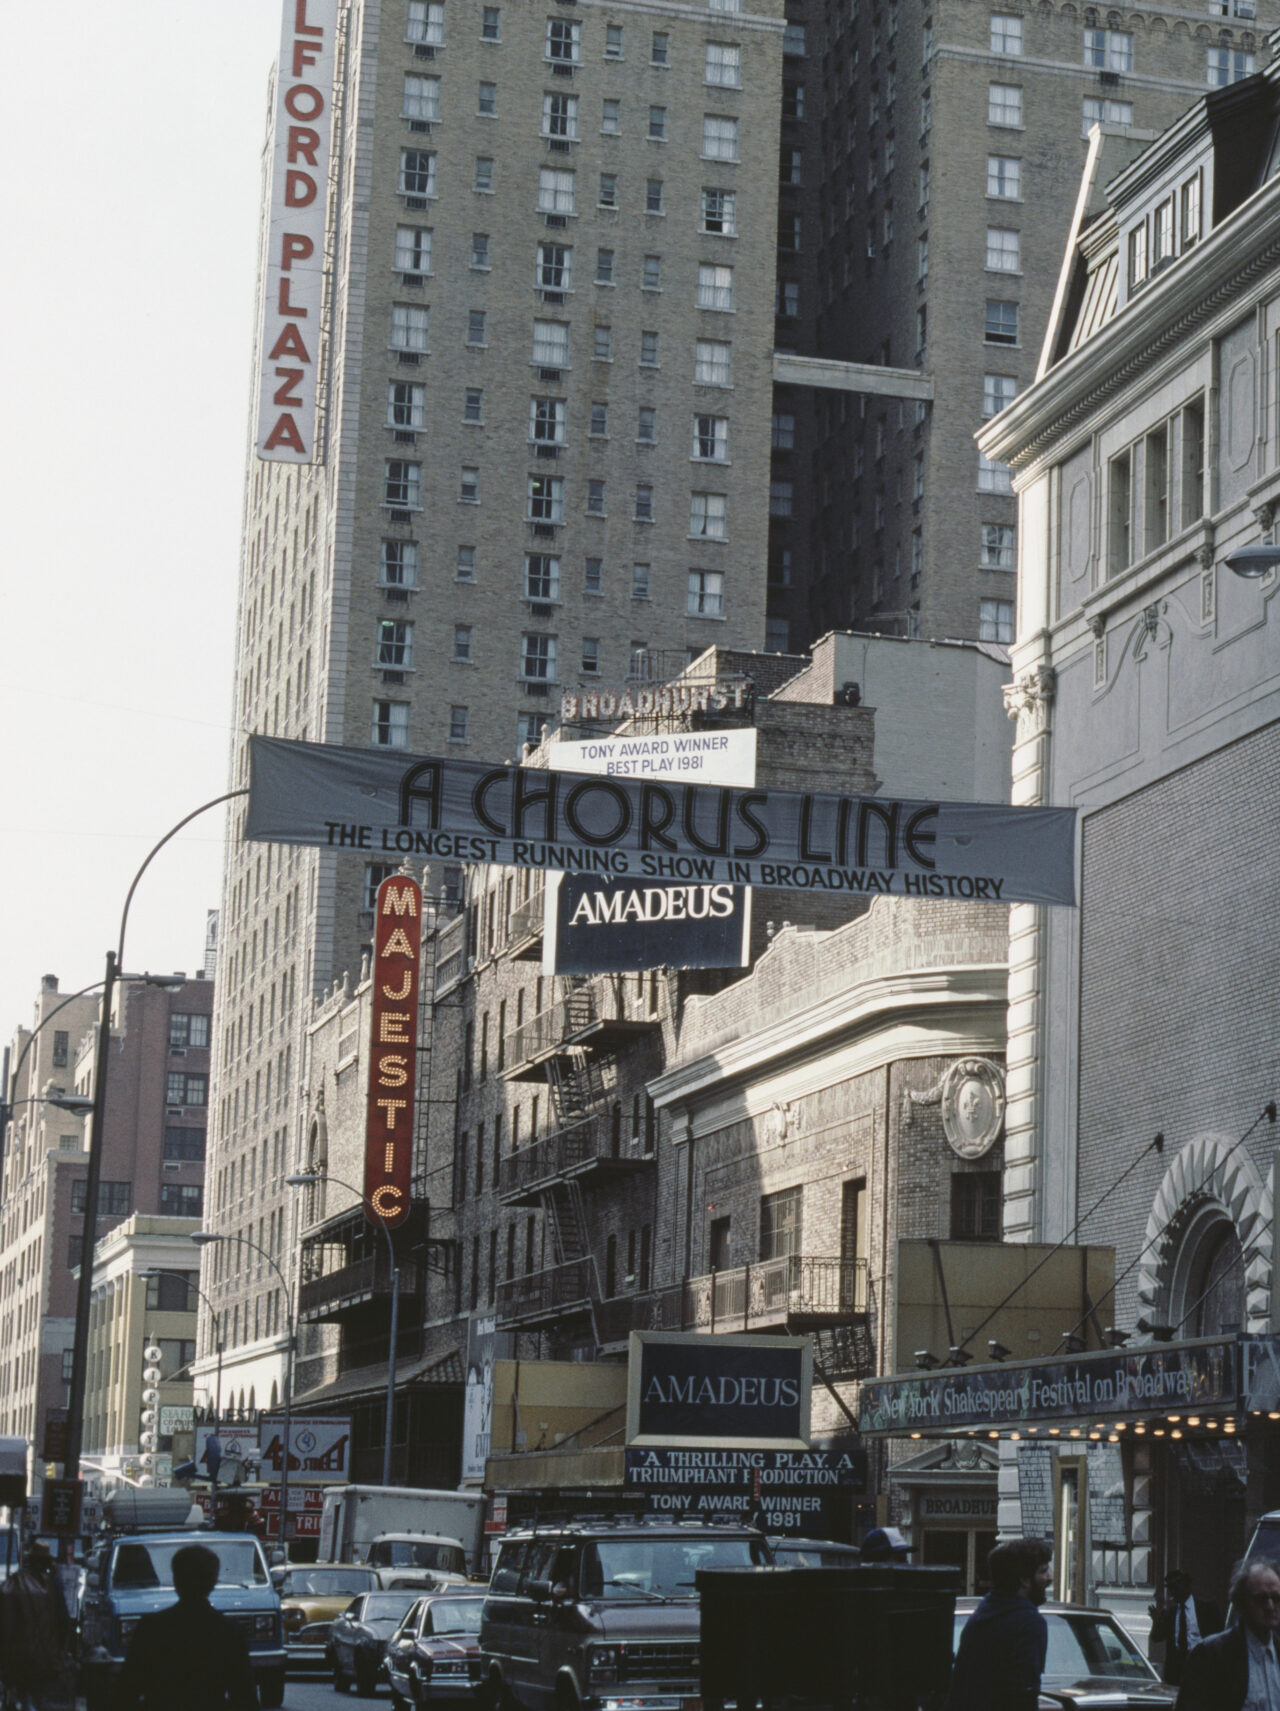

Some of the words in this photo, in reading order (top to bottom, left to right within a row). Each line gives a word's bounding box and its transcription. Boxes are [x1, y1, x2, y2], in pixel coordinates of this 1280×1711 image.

[263, 233, 314, 454] PLAZA
[561, 681, 748, 719] BROADHURST
[580, 745, 616, 760] TONY
[619, 741, 669, 757] AWARD
[673, 737, 729, 752] WINNER
[607, 760, 639, 776] BEST
[642, 758, 674, 773] PLAY
[677, 755, 704, 770] 1981
[399, 759, 445, 831] A
[471, 767, 770, 858] CHORUS
[798, 794, 941, 872] LINE
[324, 822, 372, 849] THE
[381, 828, 501, 863] LONGEST
[512, 841, 629, 874] RUNNING
[640, 853, 715, 880] SHOW
[727, 862, 751, 883] IN
[760, 864, 895, 893] BROADWAY
[904, 873, 1005, 899] HISTORY
[568, 884, 734, 925] AMADEUS
[371, 885, 418, 1219] MAJESTIC
[643, 1375, 799, 1407] AMADEUS
[883, 1394, 907, 1419] New
[909, 1391, 939, 1417] York
[944, 1382, 1030, 1417] Shakespeare
[1032, 1372, 1091, 1408] Festival
[1094, 1377, 1113, 1401] on
[1116, 1366, 1195, 1402] Broadway
[629, 1467, 738, 1484] TRIUMPHANT
[667, 1451, 765, 1468] THRILLING
[776, 1452, 829, 1469] PLAY.
[838, 1454, 854, 1469] A
[651, 1495, 692, 1510] TONY
[760, 1496, 822, 1512] WINNER
[766, 1511, 801, 1527] 1981
